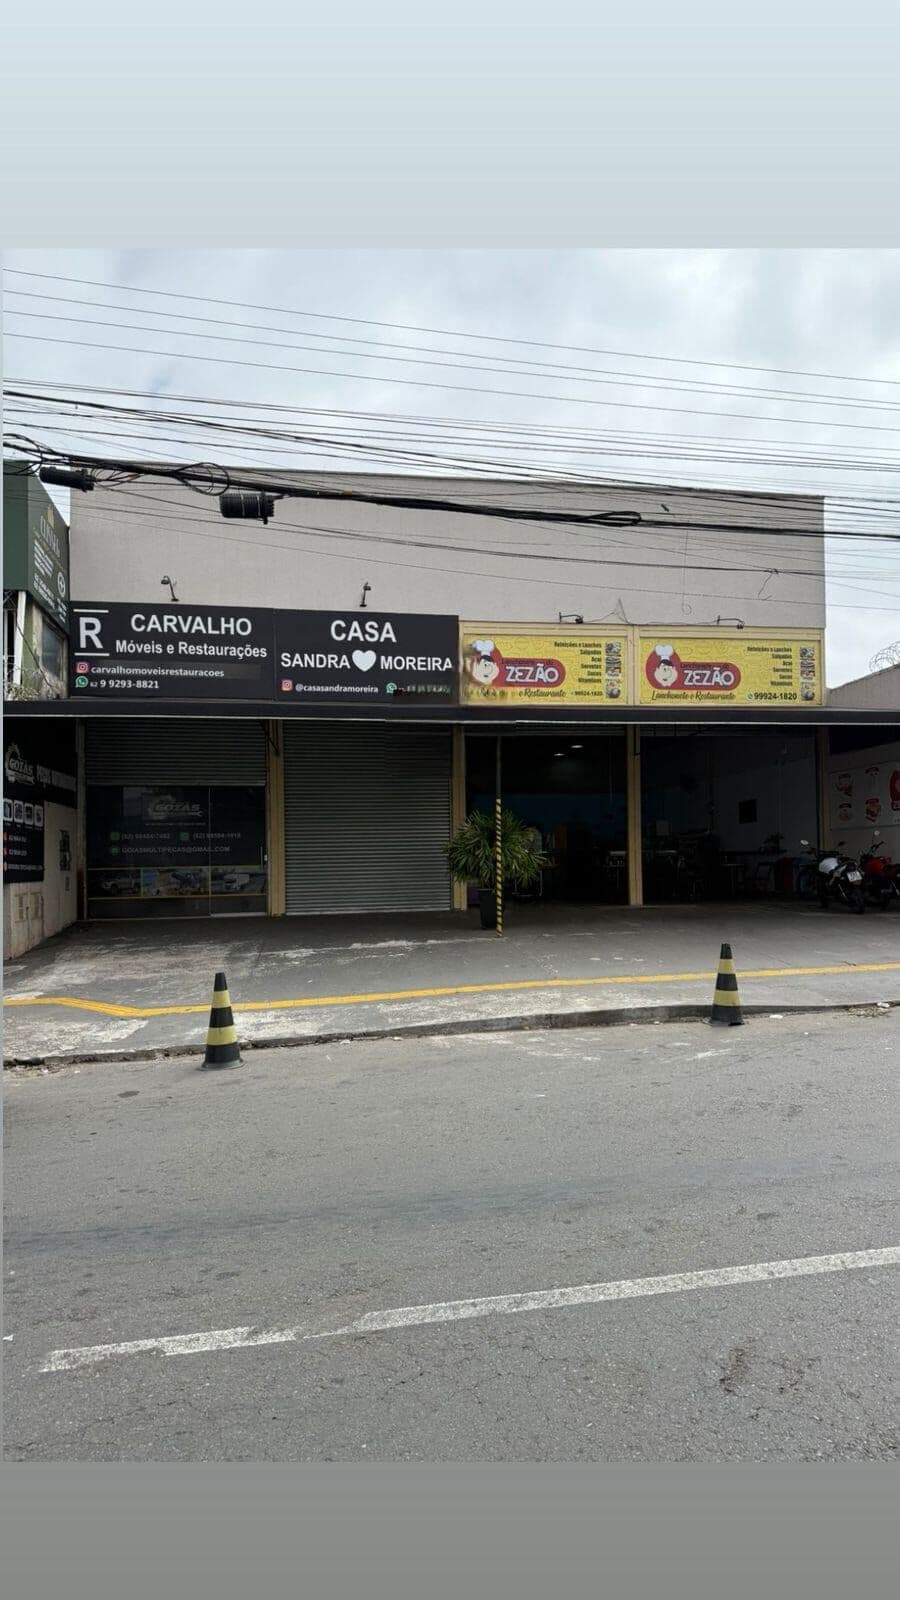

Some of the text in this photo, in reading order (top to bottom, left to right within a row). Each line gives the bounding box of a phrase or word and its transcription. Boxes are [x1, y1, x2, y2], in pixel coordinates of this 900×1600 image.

[79, 616, 103, 649] R
[130, 613, 252, 636] CARVALHO
[330, 619, 397, 643] CASA
[115, 639, 267, 660] Móveis e Restaurações
[280, 652, 453, 671] SANDRA MOREIRA
[91, 666, 225, 678] carvalhomoveisrestauracoes
[505, 663, 559, 684] ZEZÃO
[683, 667, 735, 686] ZEZÃO
[100, 680, 106, 688] 9
[108, 680, 159, 689] 9293-8821
[295, 682, 378, 694] @casasandramoreira
[524, 687, 567, 698] Restaurante
[754, 692, 797, 700] 99924-1820
